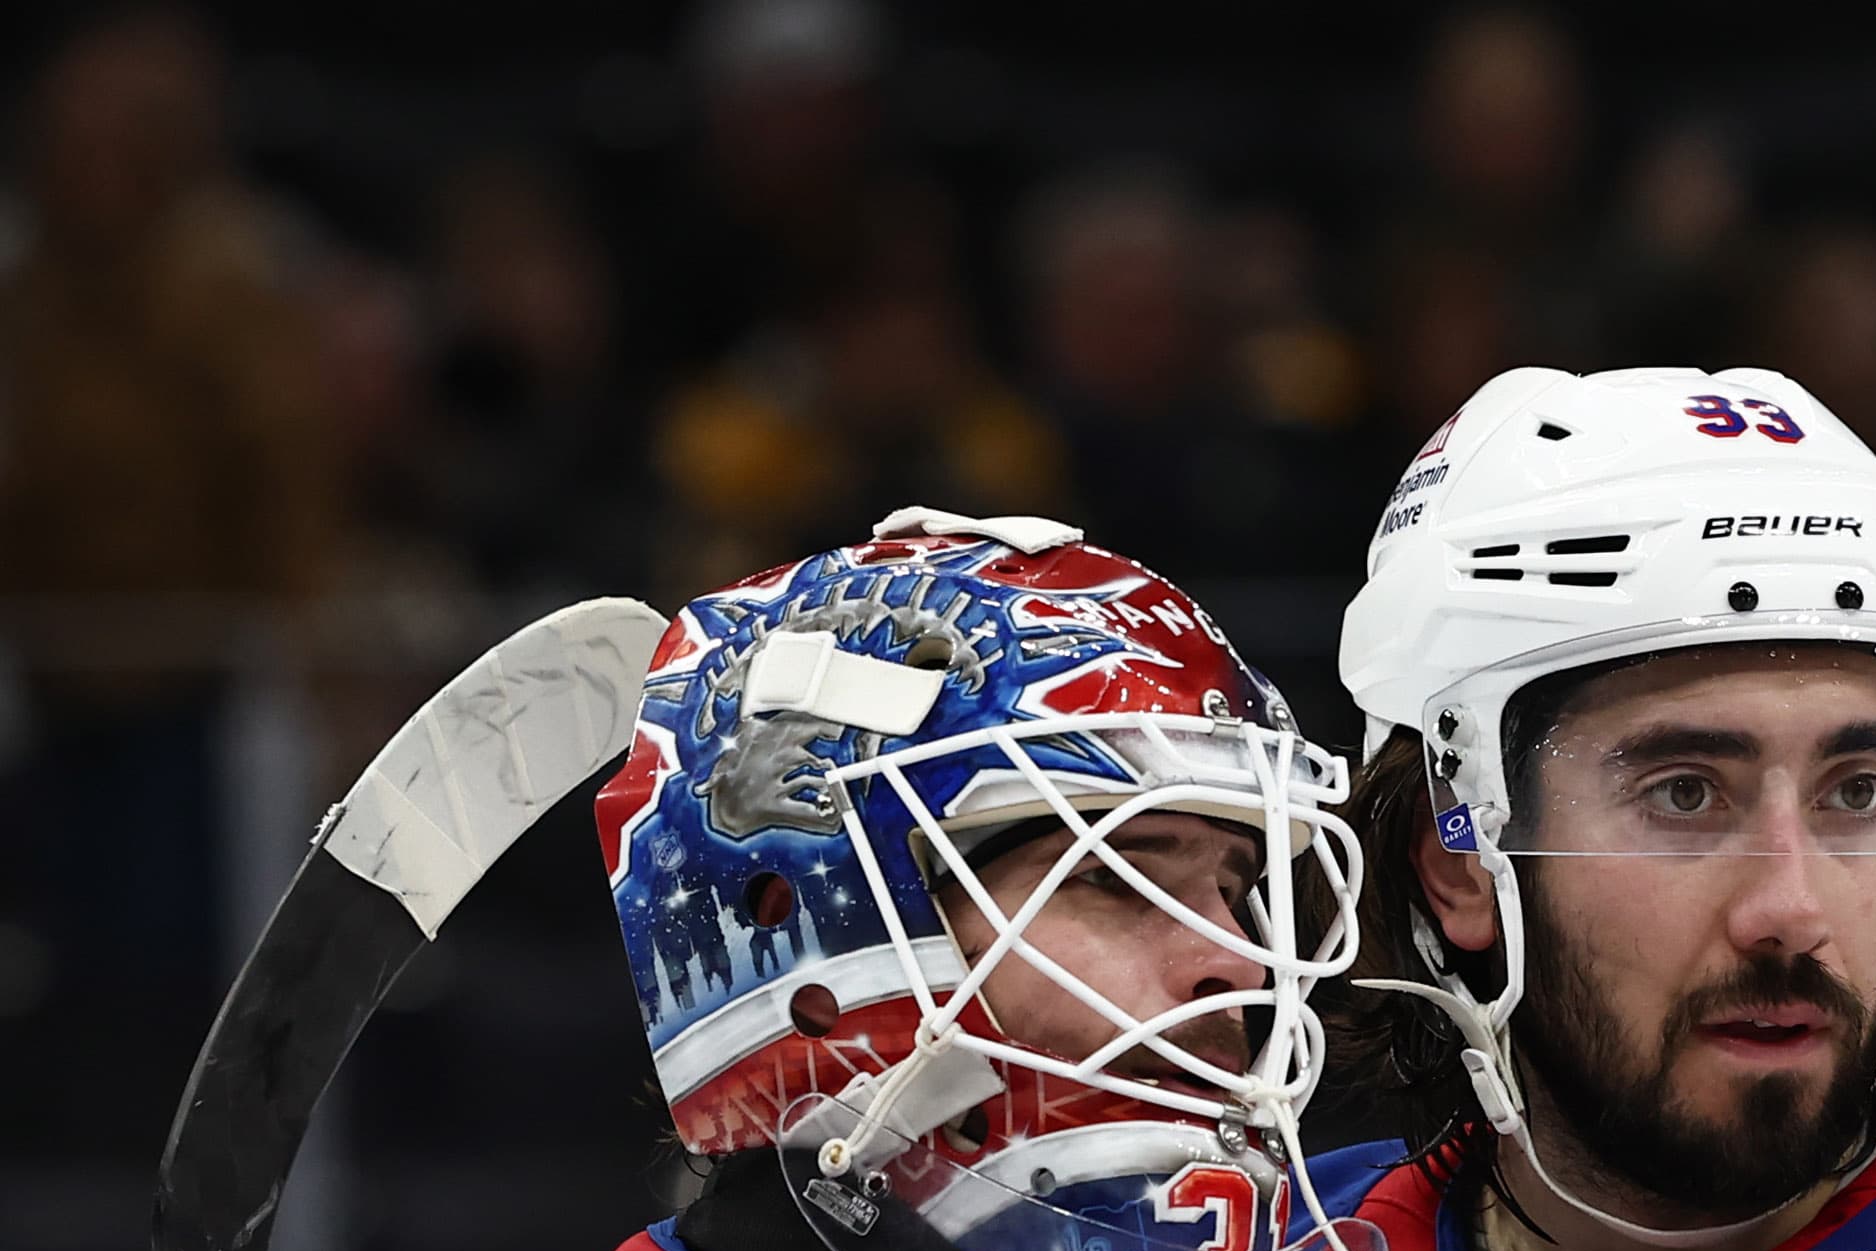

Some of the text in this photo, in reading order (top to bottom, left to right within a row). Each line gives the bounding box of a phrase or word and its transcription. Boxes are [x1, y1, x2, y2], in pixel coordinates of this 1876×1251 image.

[1682, 394, 1805, 444] 93
[1386, 457, 1450, 506] enjamin
[1701, 515, 1863, 540] BAUER
